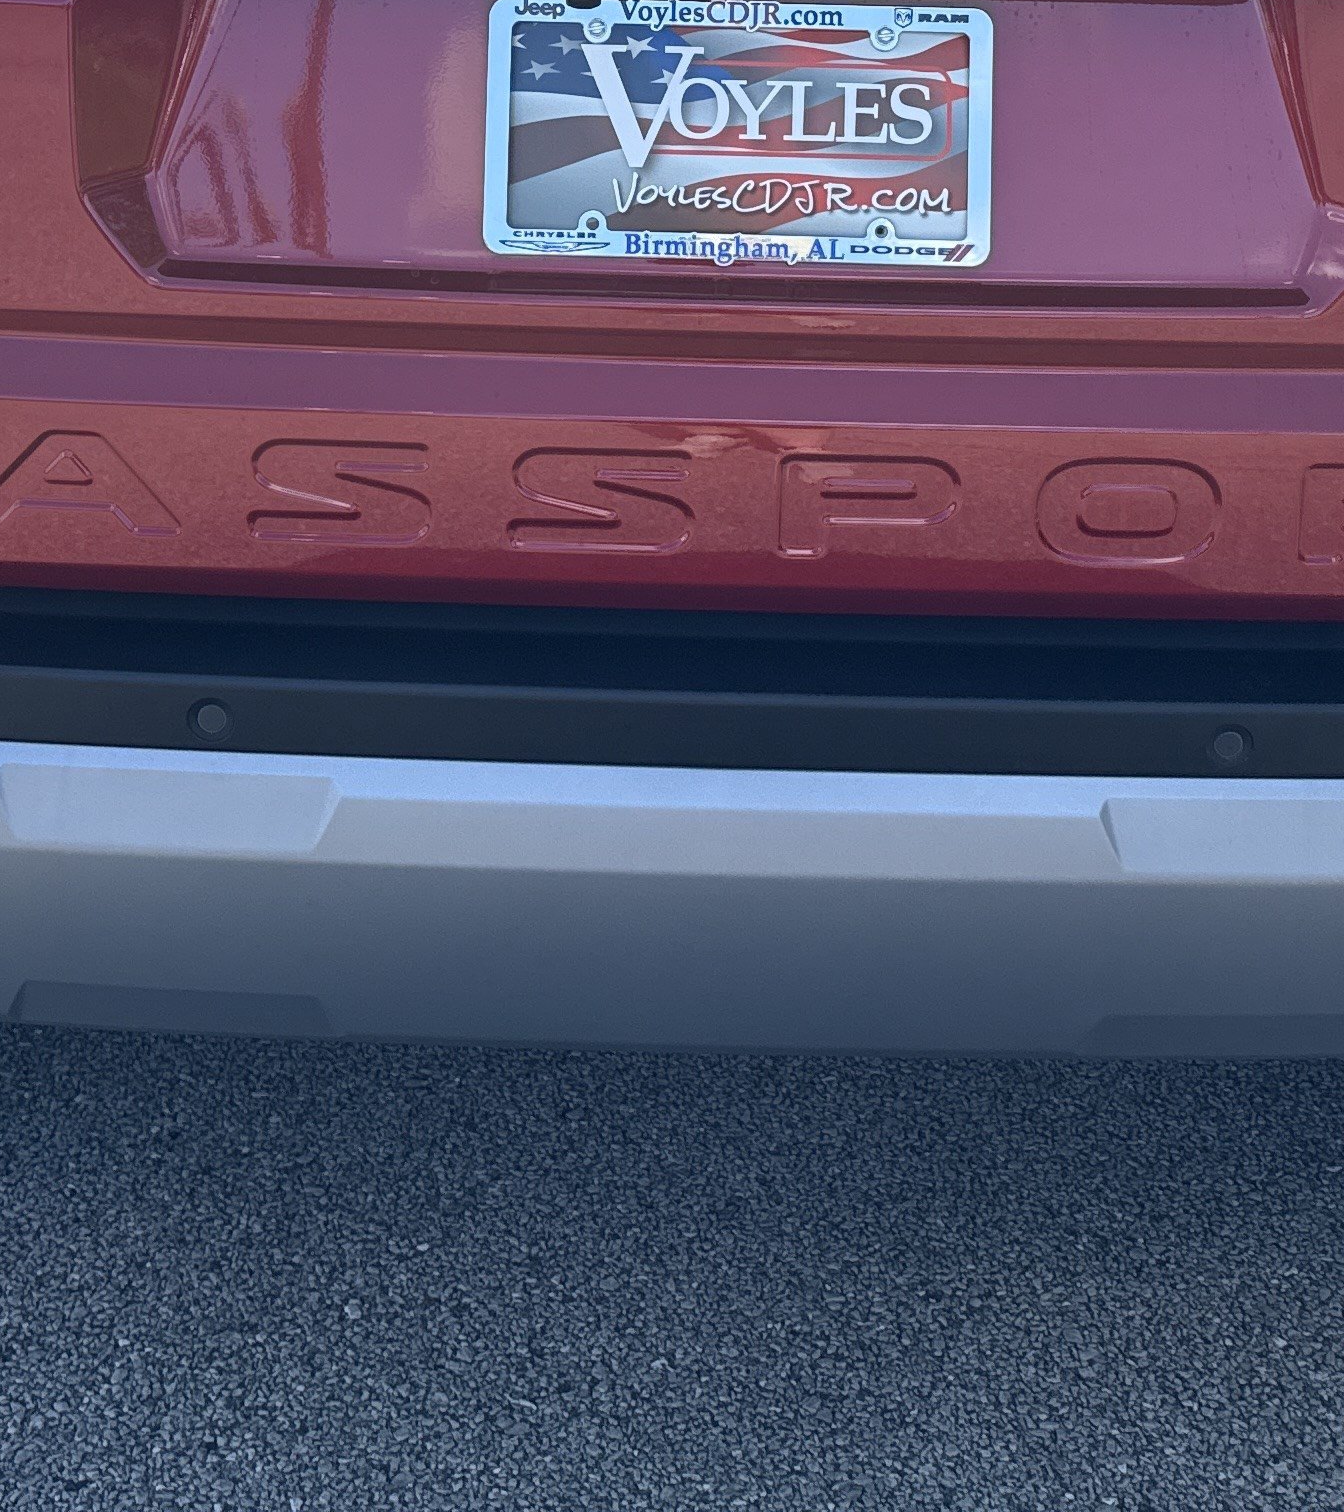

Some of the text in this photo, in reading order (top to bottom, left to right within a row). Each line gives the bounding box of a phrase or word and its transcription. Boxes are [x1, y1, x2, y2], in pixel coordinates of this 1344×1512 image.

[917, 13, 970, 24] RAM
[512, 230, 597, 239] CHRYSLER
[624, 233, 845, 263] Birmingham, AL
